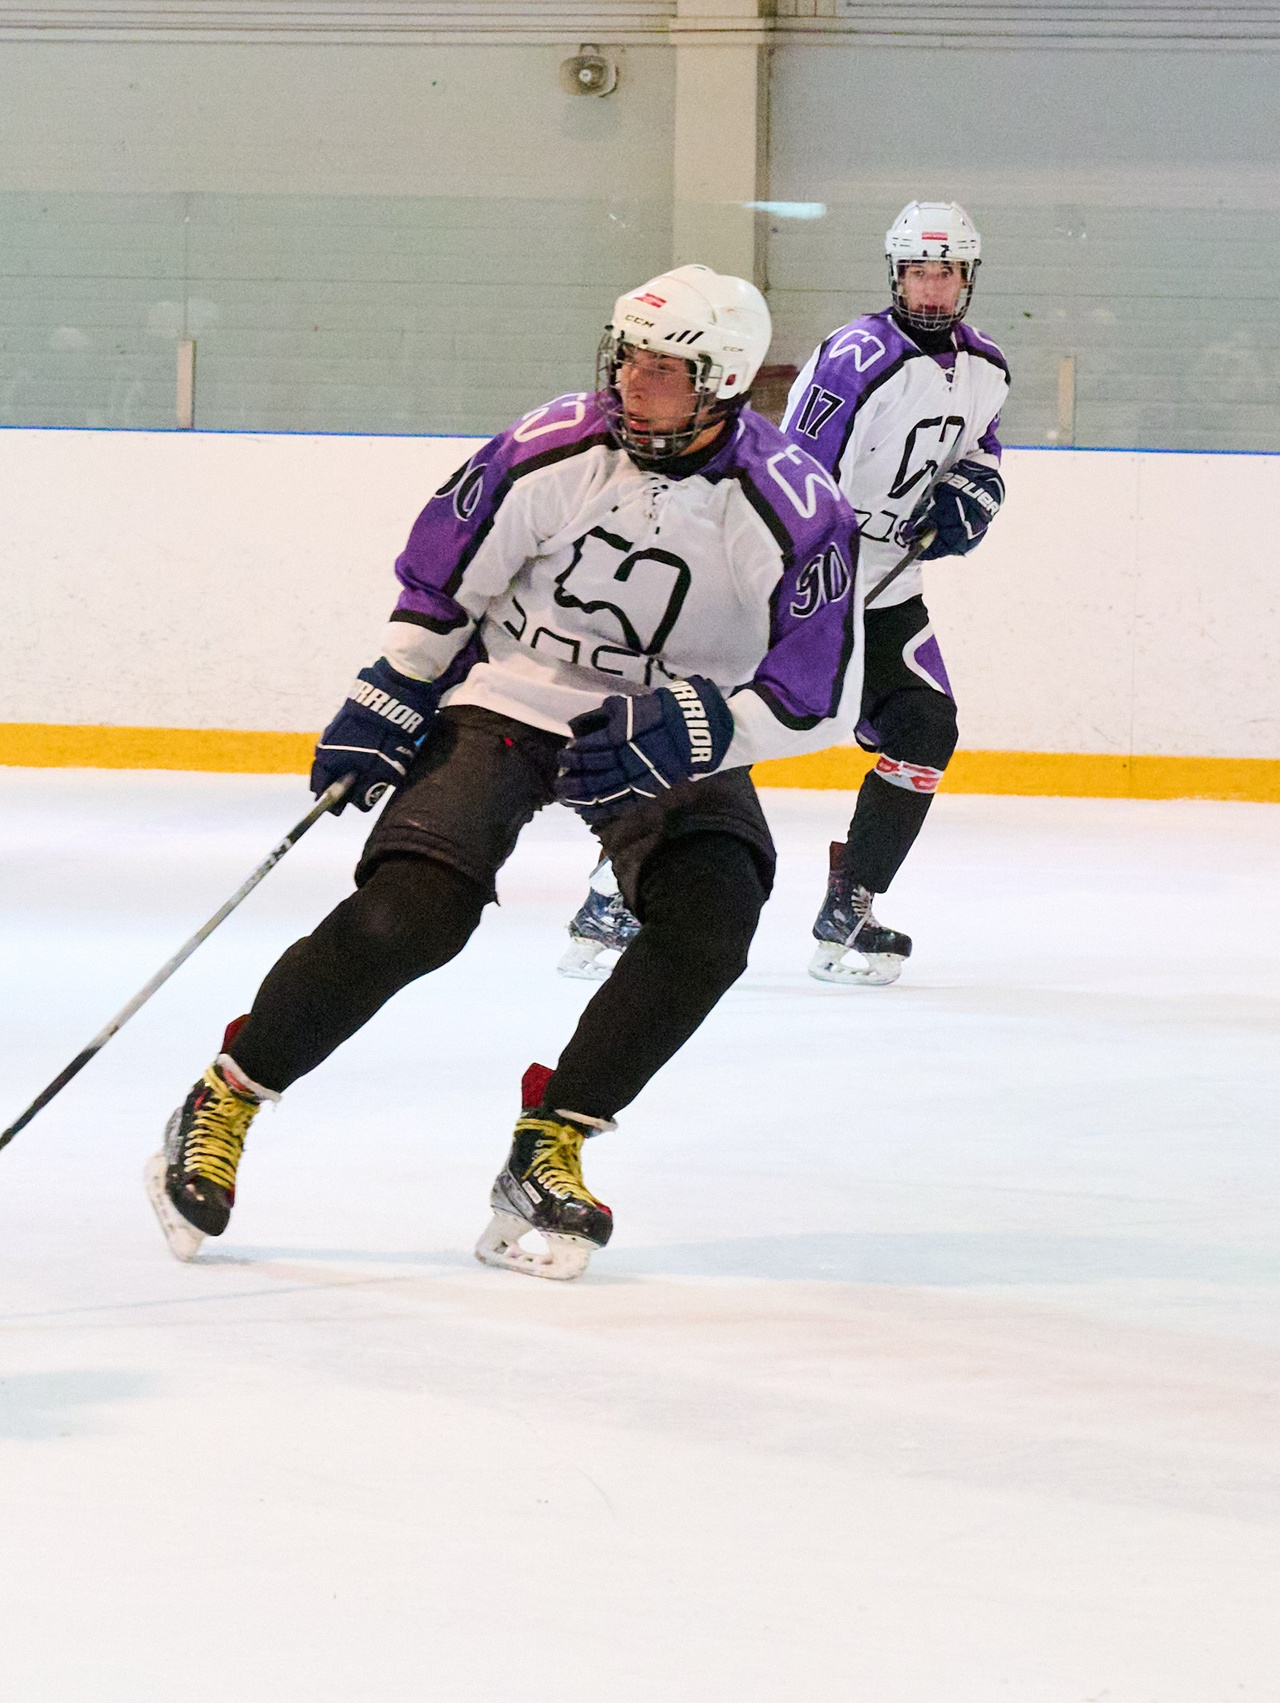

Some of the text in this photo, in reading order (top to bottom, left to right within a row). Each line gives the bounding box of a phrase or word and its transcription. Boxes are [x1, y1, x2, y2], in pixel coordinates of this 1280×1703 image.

[624, 314, 655, 328] CCM
[796, 384, 845, 440] 17
[789, 541, 852, 618] 90
